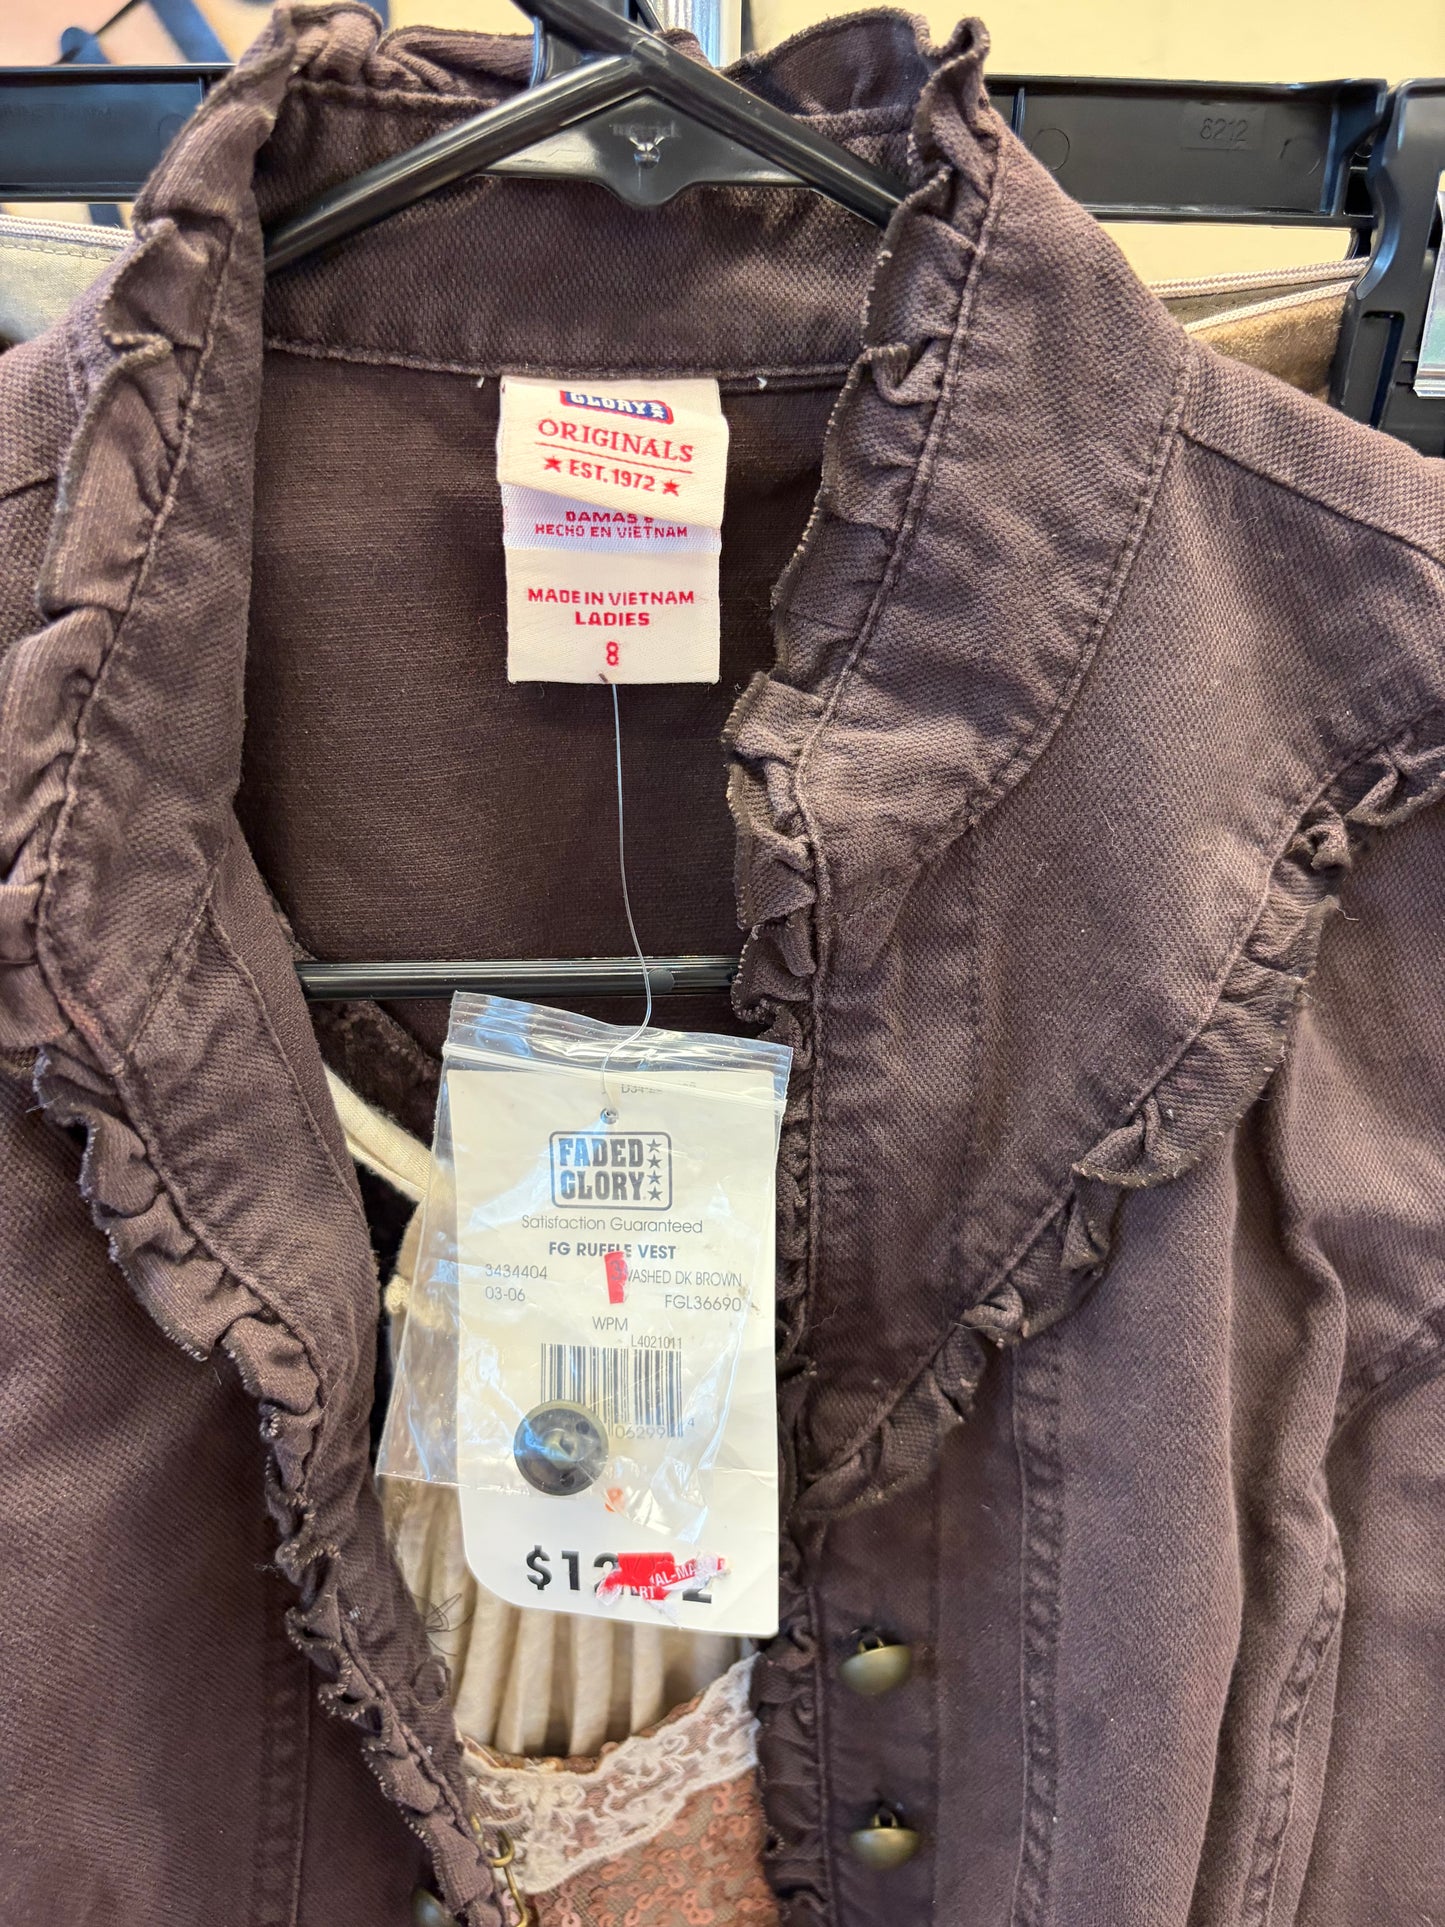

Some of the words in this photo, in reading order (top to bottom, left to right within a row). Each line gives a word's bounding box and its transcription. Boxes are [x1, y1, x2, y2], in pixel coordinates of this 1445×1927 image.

[538, 419, 694, 462] ORIGINALS
[565, 510, 637, 524] DAMAS
[535, 524, 585, 537] HECHO
[590, 526, 611, 538] EN
[617, 526, 688, 539] VIETNAM
[528, 588, 581, 604] MADE
[585, 590, 604, 606] IN
[608, 591, 695, 606] VIETNAM
[575, 611, 650, 626] LADIES
[606, 641, 619, 666] 8
[558, 1137, 644, 1168] FADED
[560, 1171, 645, 1201] GLORY
[521, 1215, 606, 1231] Satisfaction
[610, 1217, 703, 1234] Guaranteed
[549, 1242, 571, 1256] FG
[638, 1244, 676, 1259] VEST
[485, 1263, 548, 1280] 3434404
[675, 1271, 692, 1286] DK
[695, 1272, 742, 1288] BROWN
[485, 1287, 526, 1302] 03-06
[664, 1294, 742, 1312] FGL36690
[592, 1316, 628, 1332] WPM
